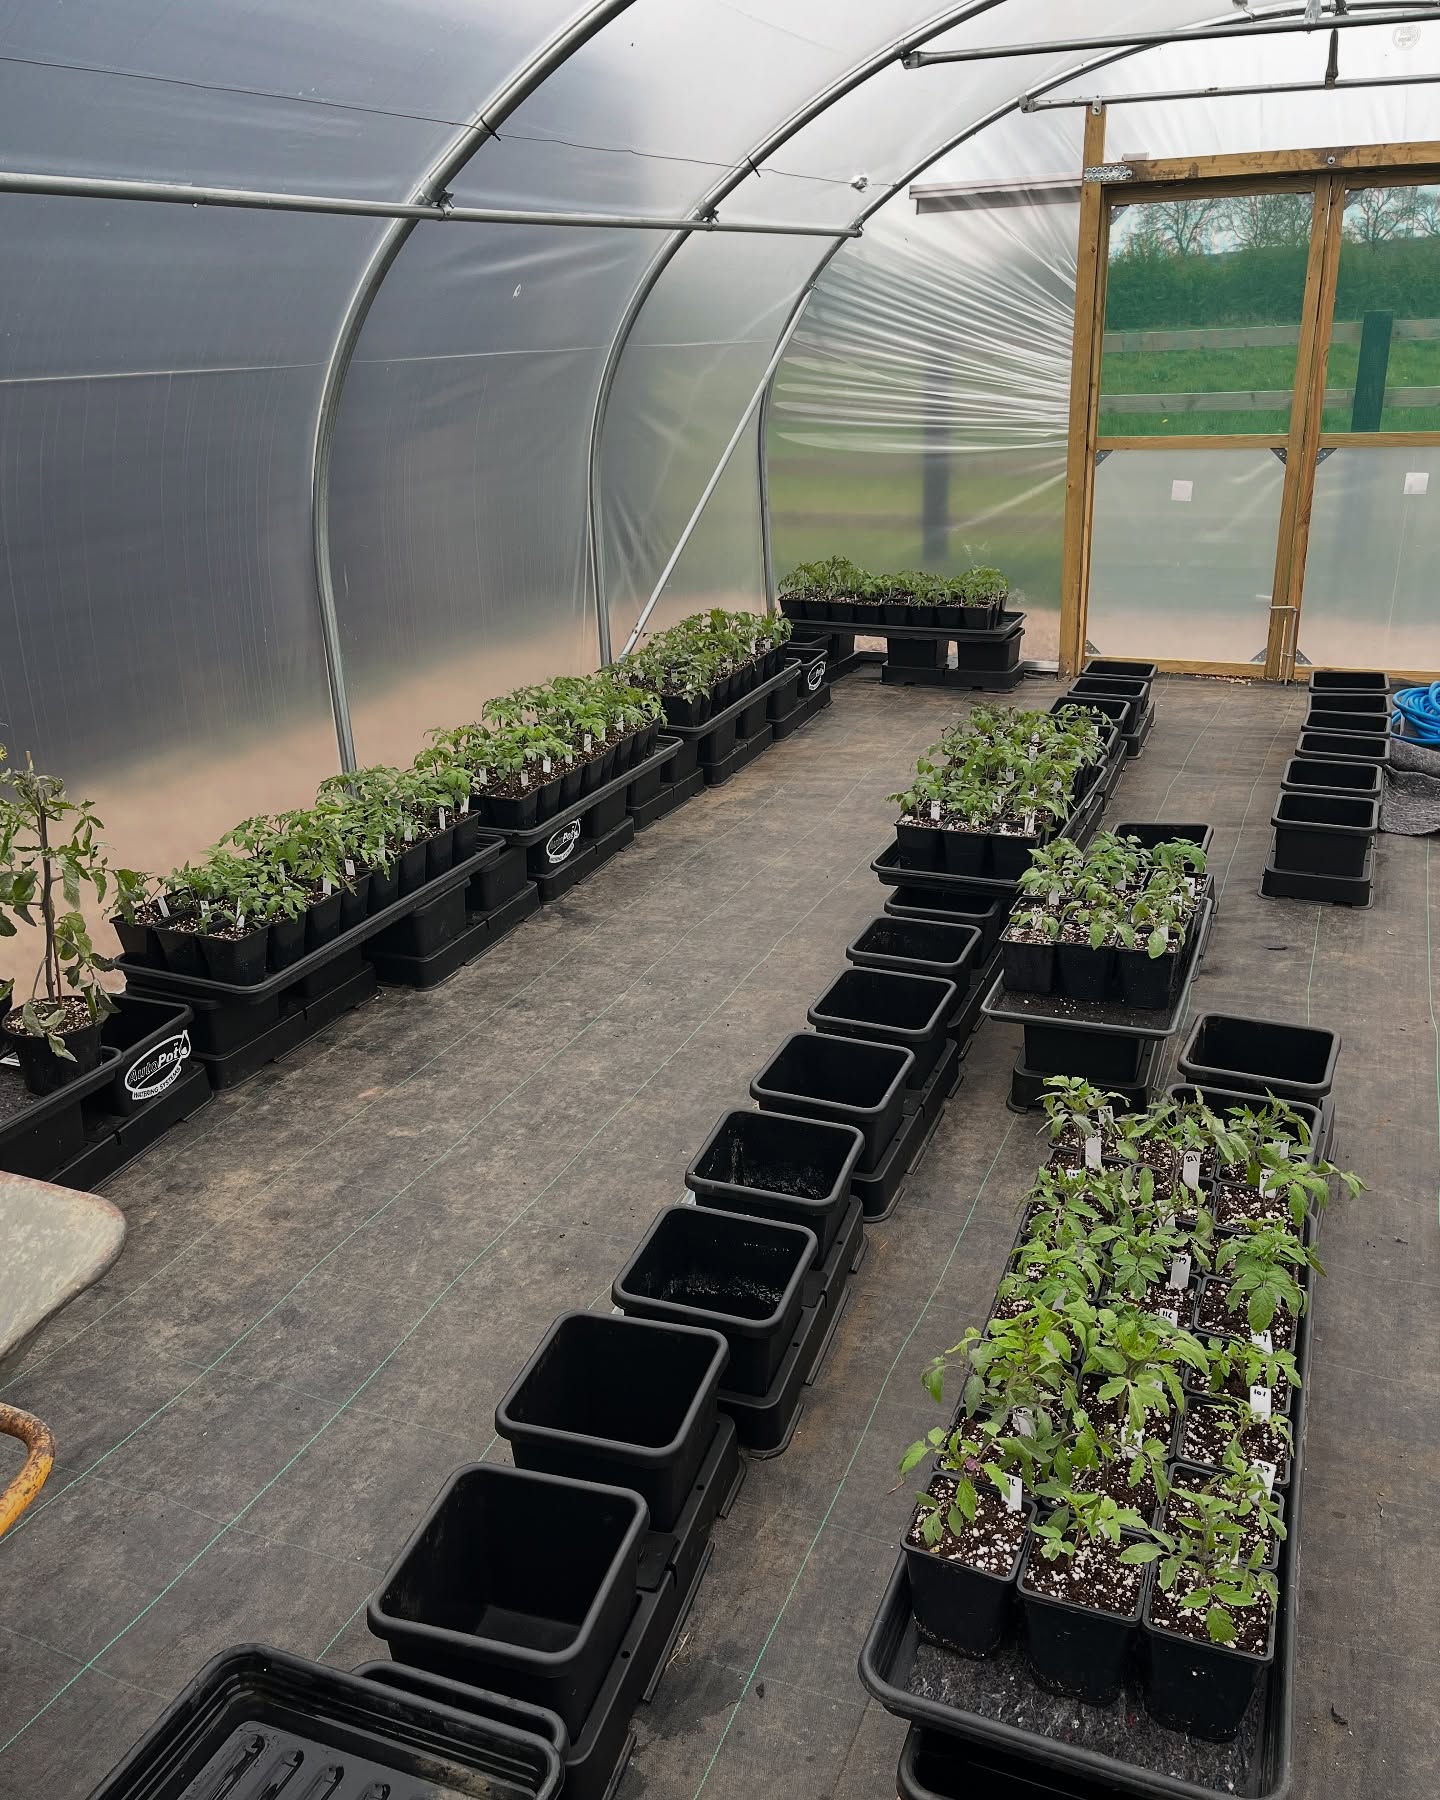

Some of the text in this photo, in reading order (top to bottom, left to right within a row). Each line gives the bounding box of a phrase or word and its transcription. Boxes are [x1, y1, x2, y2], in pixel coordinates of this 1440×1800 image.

[128, 1046, 179, 1086] AutoPot
[133, 1066, 181, 1098] WATERING SYSTEMS
